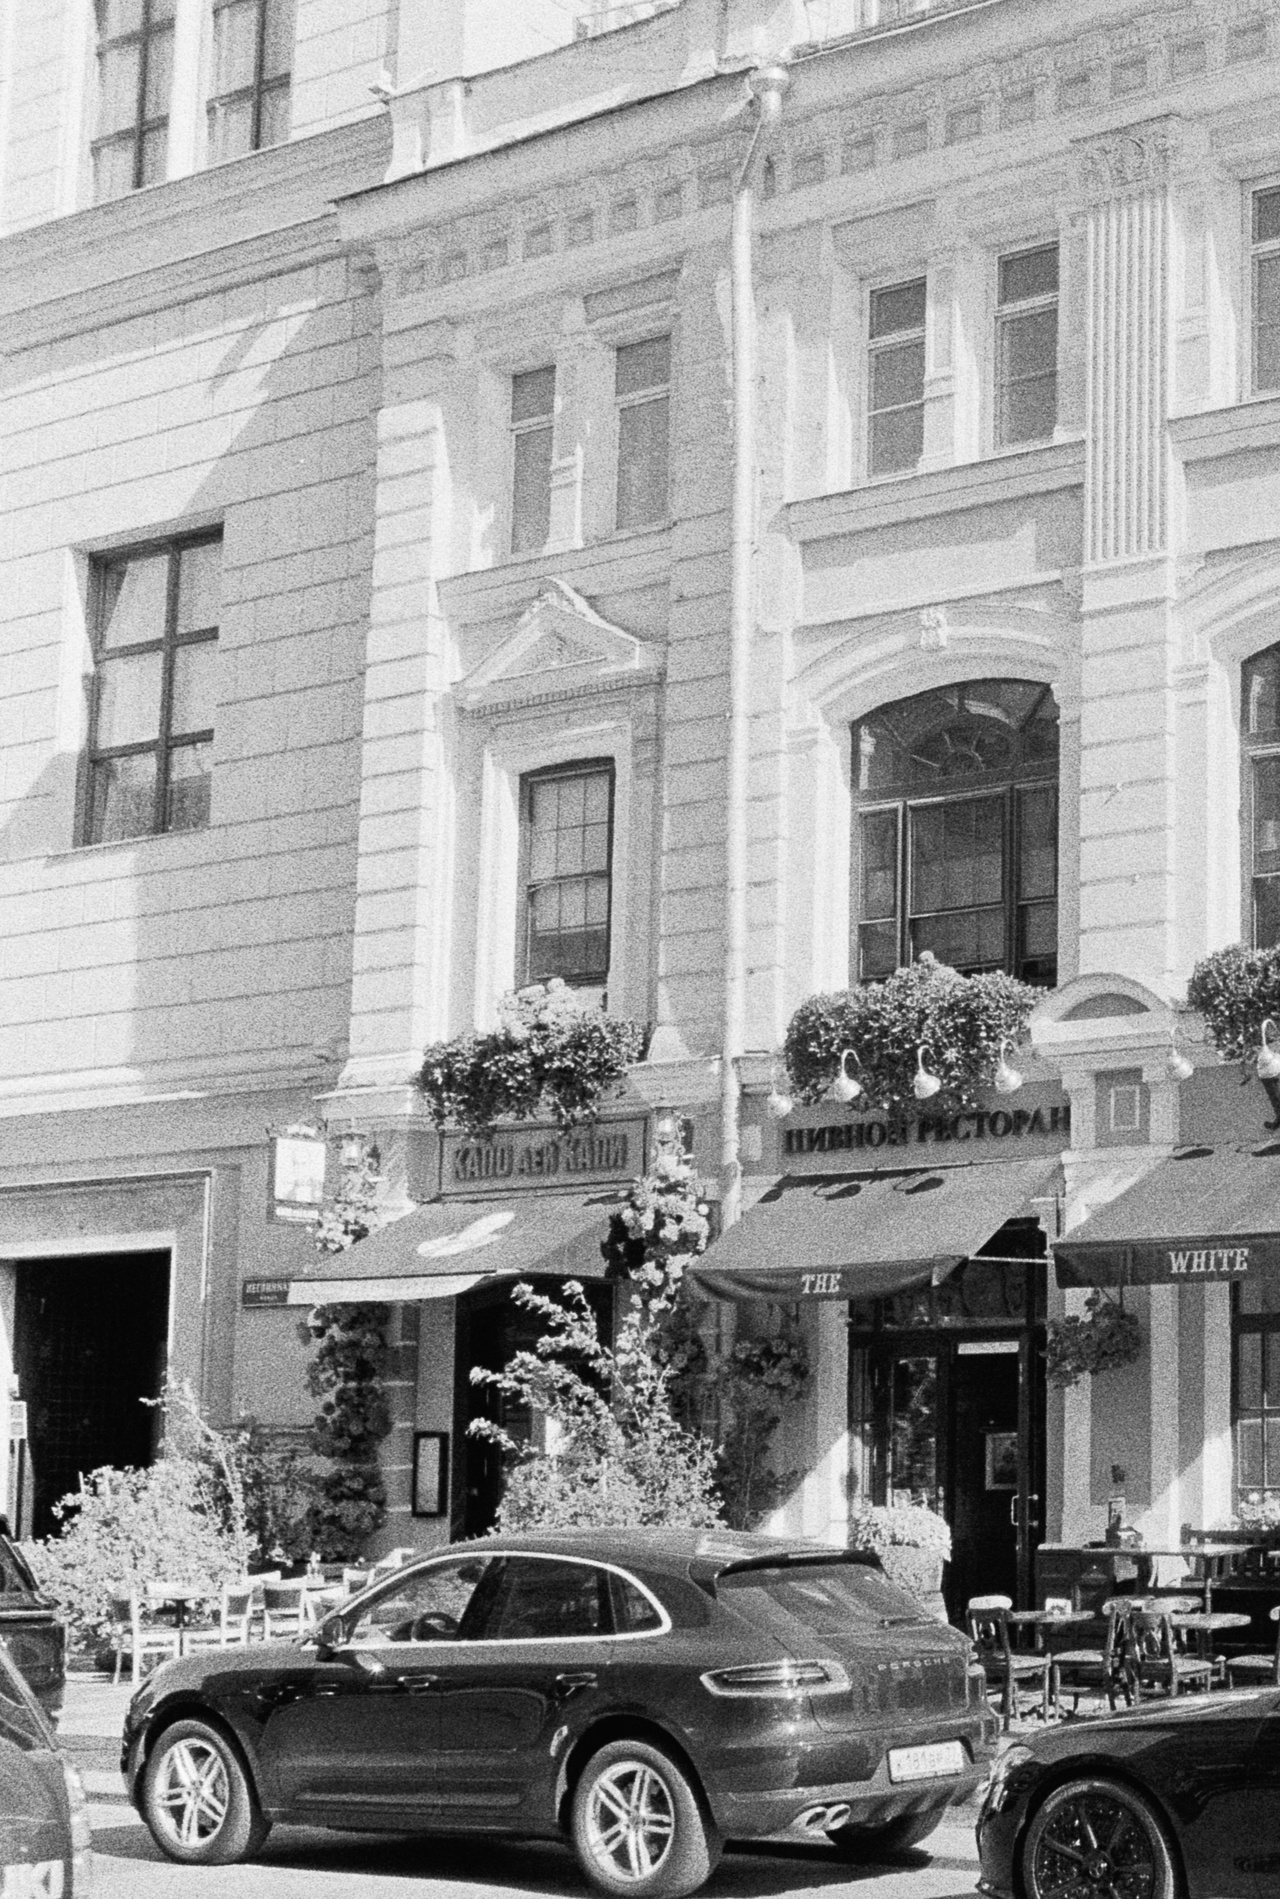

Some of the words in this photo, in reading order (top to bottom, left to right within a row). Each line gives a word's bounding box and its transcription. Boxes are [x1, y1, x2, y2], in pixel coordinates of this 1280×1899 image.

[916, 1105, 1071, 1143] РЕСТОРАН
[1168, 1247, 1249, 1274] WHITE
[801, 1272, 842, 1294] THE
[877, 1656, 950, 1671] PORSCHE
